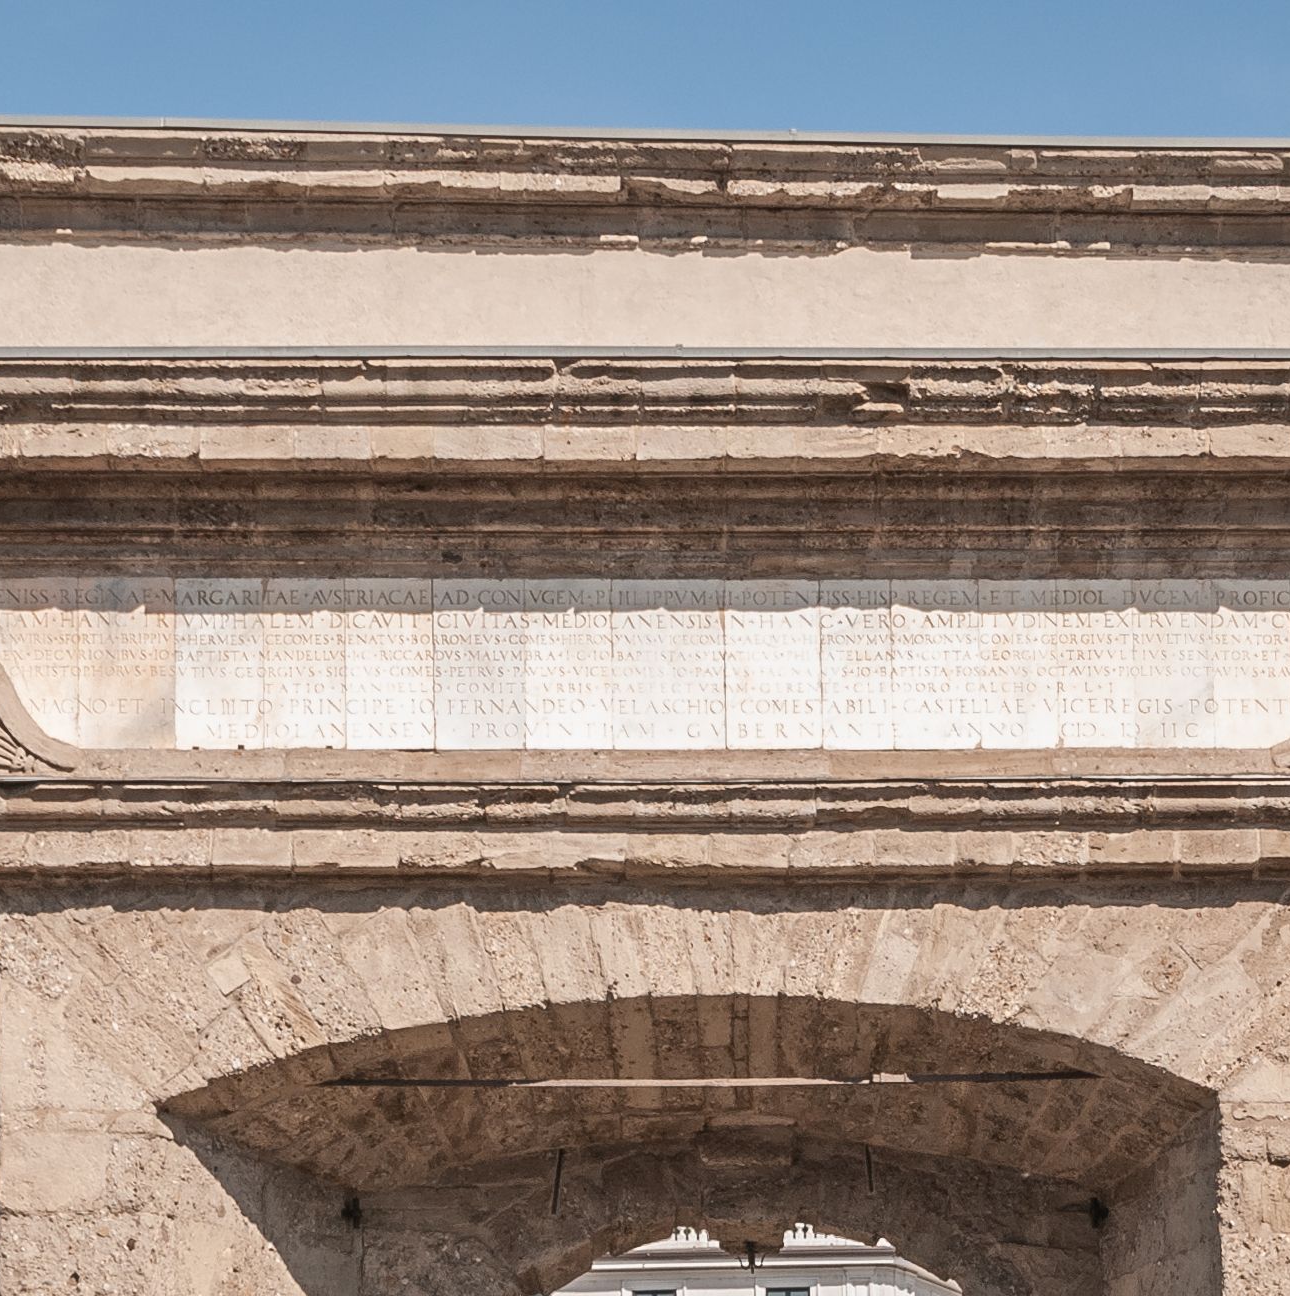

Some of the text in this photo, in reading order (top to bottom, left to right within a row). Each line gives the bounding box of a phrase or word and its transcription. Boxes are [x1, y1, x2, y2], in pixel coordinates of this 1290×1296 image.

[59, 589, 153, 605] REGINAE
[161, 589, 299, 605] MARGARITAE
[310, 589, 428, 605] AVSTRIACAE
[440, 589, 469, 605] AD
[857, 589, 898, 605] HISP
[908, 589, 979, 605] REGEM
[990, 589, 1021, 605] ET
[1031, 589, 1109, 605] MEDIOL
[1122, 589, 1200, 605] DVCEM
[60, 614, 127, 629] HANC
[329, 614, 419, 629] DICAVIT
[437, 614, 530, 629] CIVITAS
[542, 614, 711, 629] MEDIOLANENSIS
[759, 614, 833, 629] HANC
[845, 614, 906, 629] VERO
[59, 633, 115, 645] SFORTIA
[188, 633, 245, 645] HERMES
[336, 633, 405, 645] RENATVS
[411, 633, 501, 645] BORROMEVS
[508, 633, 556, 645] COMES
[980, 633, 1032, 645] COMES
[1042, 633, 1113, 645] GEORGIVS
[1215, 633, 1282, 645] SENATOR
[34, 649, 147, 661] DECVRIONIBVS
[176, 649, 249, 661] BAPTISTA
[1261, 649, 1279, 661] ET
[449, 667, 505, 678] PETRVS
[117, 698, 143, 715] ET
[289, 698, 396, 715] PRINCIPE
